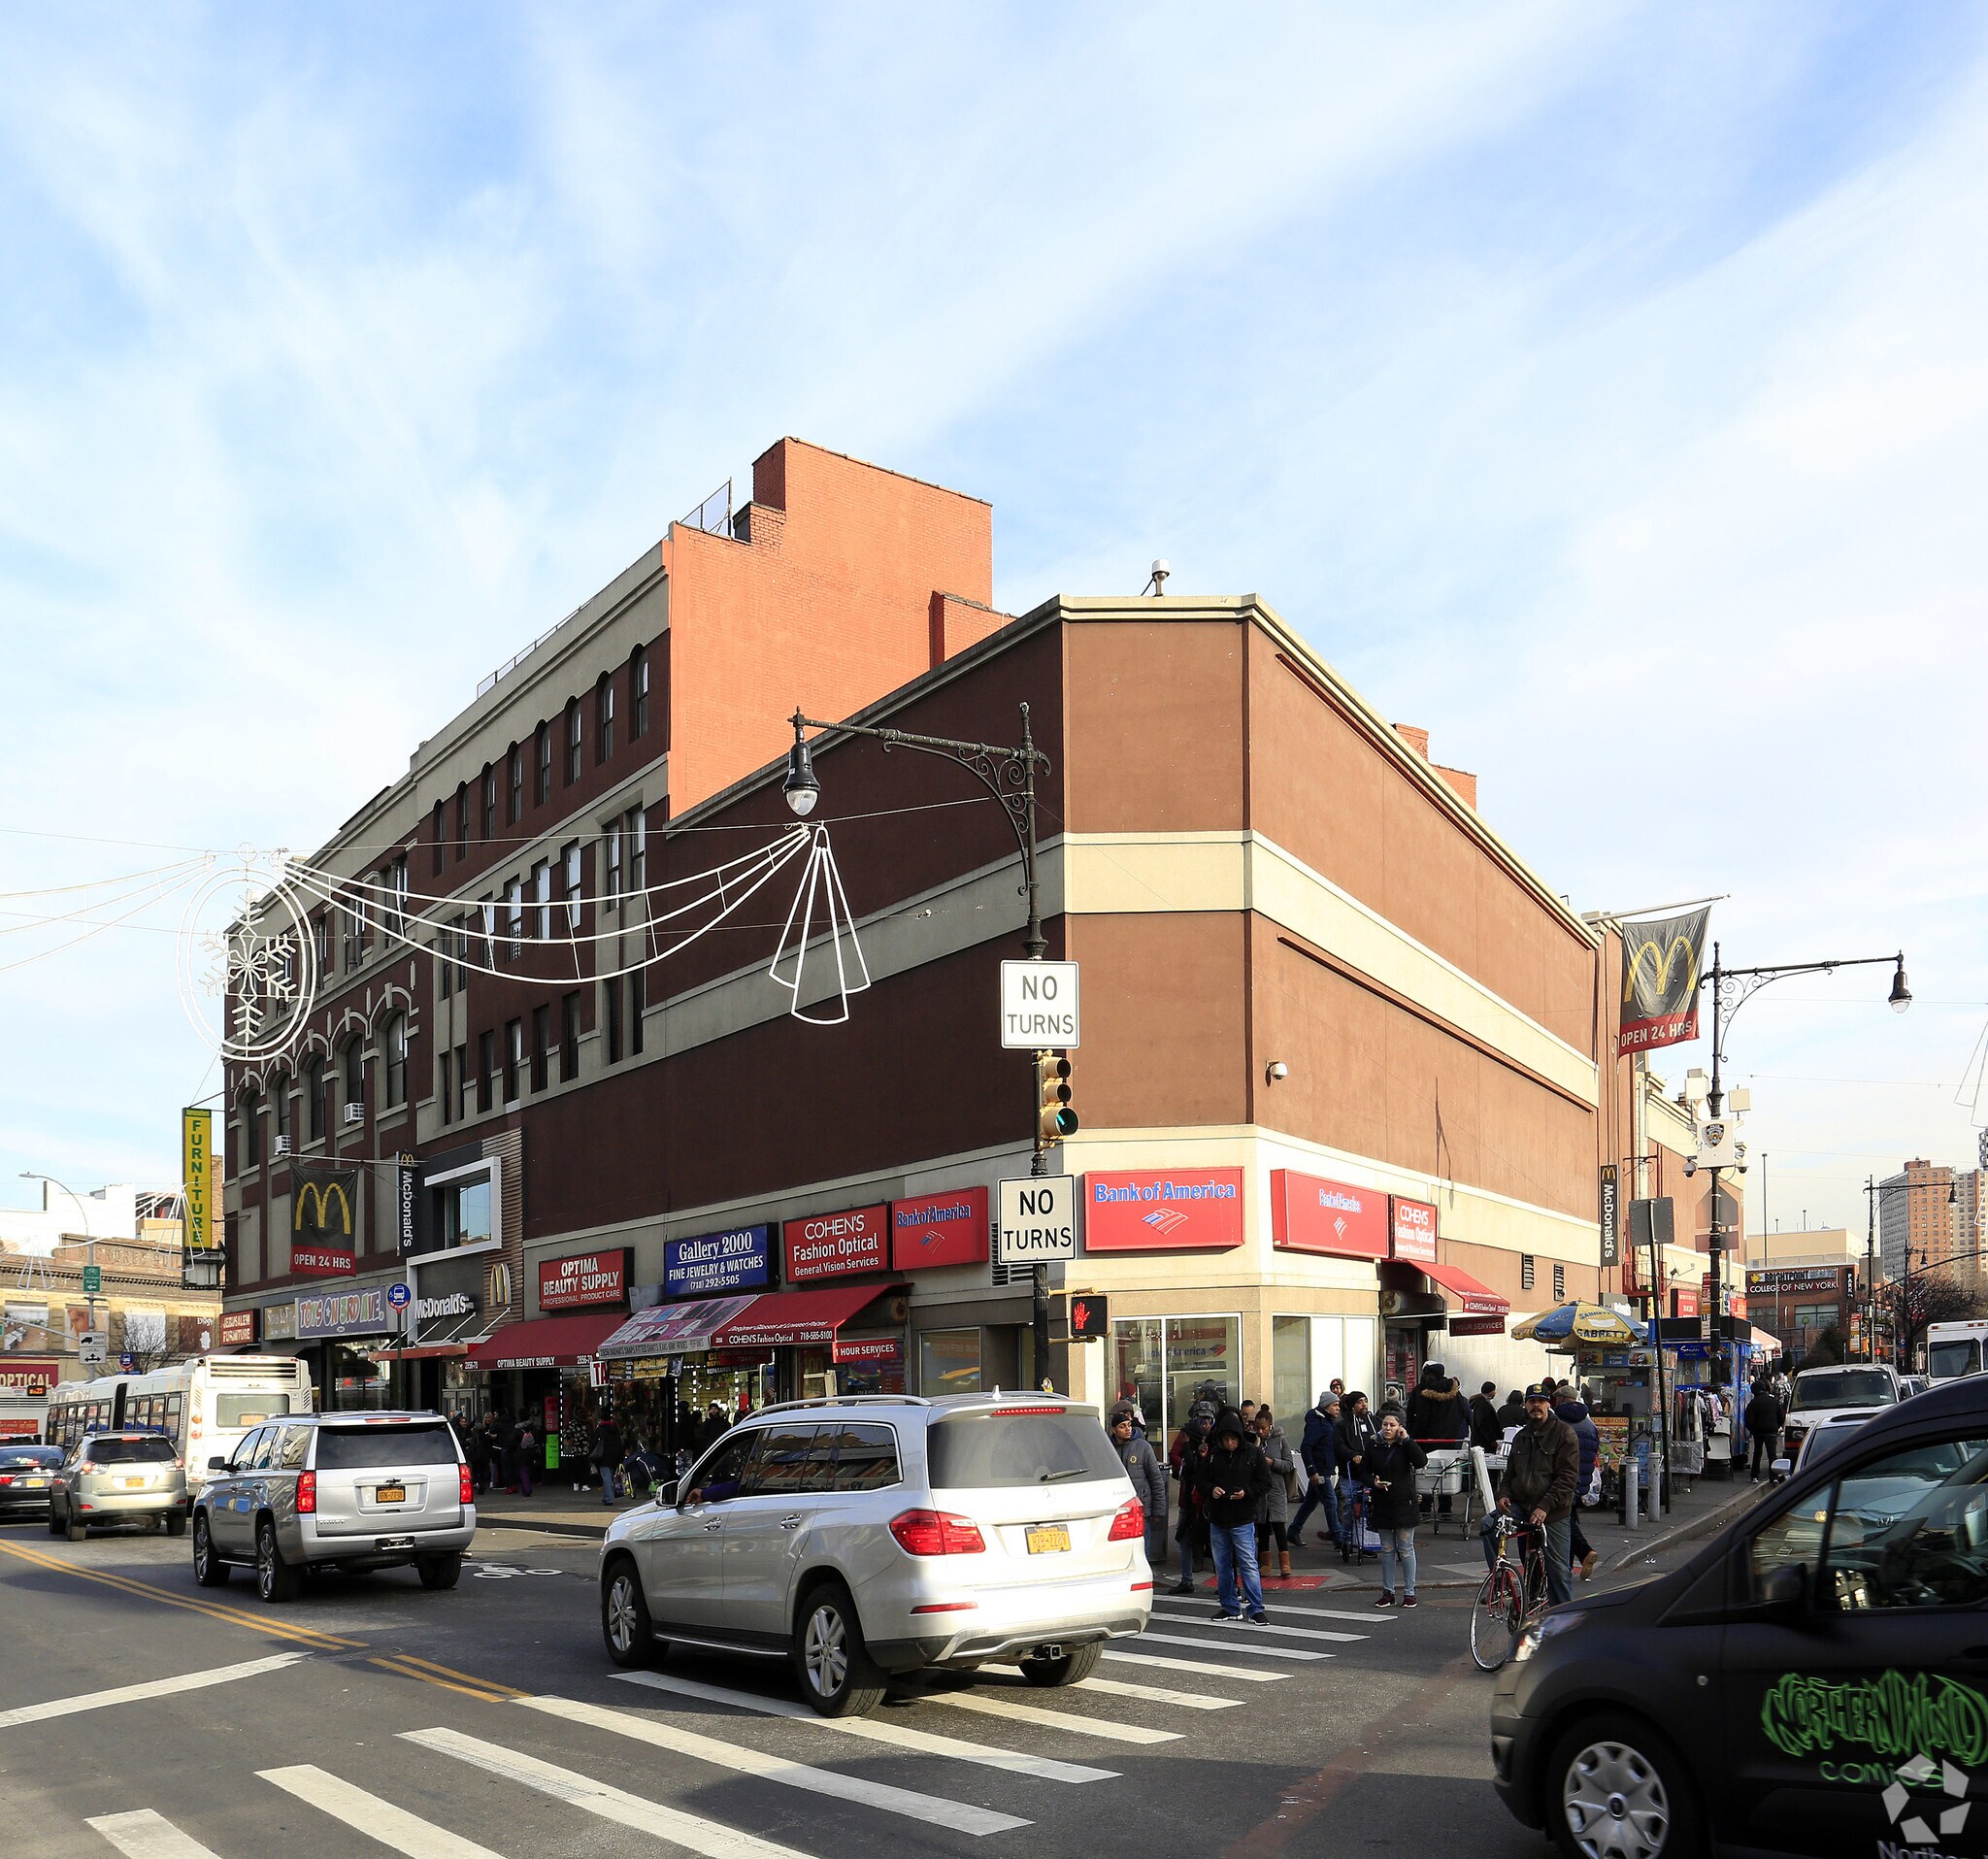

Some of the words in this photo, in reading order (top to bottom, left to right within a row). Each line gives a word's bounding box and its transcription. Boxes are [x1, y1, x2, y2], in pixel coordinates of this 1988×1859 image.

[1022, 975, 1058, 1001] NO
[1007, 1013, 1075, 1035] TURNS
[1621, 1028, 1648, 1047] OPEN
[1651, 1026, 1666, 1041] 24
[1670, 1020, 1693, 1038] HRS
[190, 1119, 203, 1243] FURNITURE
[1094, 1182, 1142, 1203] Bank
[1142, 1180, 1161, 1201] of
[1162, 1179, 1237, 1201] America
[402, 1171, 414, 1247] McDonald's
[1019, 1188, 1054, 1216] NO
[896, 1211, 920, 1228] Bank
[920, 1208, 931, 1224] of
[931, 1202, 972, 1222] America
[1604, 1183, 1614, 1258] McDonald's
[804, 1213, 865, 1241] COHEN'S
[1003, 1226, 1072, 1251] TURNS
[679, 1241, 720, 1261] Gallery
[721, 1231, 752, 1254] 2000
[793, 1242, 836, 1262] Fashion
[838, 1232, 878, 1257] Optical
[294, 1253, 316, 1267] OPEN
[318, 1255, 331, 1267] 24
[332, 1256, 351, 1269] HRS
[560, 1257, 599, 1278] OPTIMA
[669, 1267, 685, 1281] FINE
[685, 1262, 719, 1278] JEWELRY
[719, 1261, 726, 1274] &
[726, 1254, 764, 1273] WATCHES
[794, 1262, 823, 1278] General
[823, 1259, 845, 1274] Vision
[845, 1255, 879, 1270] Services
[543, 1277, 579, 1296] BEAUTY
[581, 1271, 619, 1291] SUPPLY
[690, 1279, 705, 1291] (718)
[705, 1274, 740, 1289] 292-5505
[1749, 1284, 1780, 1293] COLLEGE
[1794, 1282, 1814, 1291] NEW
[300, 1298, 323, 1328] TOYS
[323, 1297, 340, 1327] ON
[340, 1295, 361, 1324] 3RD
[360, 1290, 385, 1323] AVE.
[414, 1292, 468, 1320] McDonald's
[543, 1295, 579, 1306] PROFESSIONAL
[580, 1291, 606, 1301] PRODUCT
[222, 1312, 250, 1328] JERUSALEM
[1474, 1321, 1504, 1330] SERVICES
[1578, 1311, 1612, 1320] SABRETT
[222, 1327, 250, 1343] FURNITURE
[728, 1334, 757, 1344] COHEN'S
[757, 1333, 774, 1344] Fashion
[775, 1332, 794, 1344] Optical
[1576, 1328, 1627, 1339] SABRETT
[841, 1346, 861, 1356] HOUR
[861, 1344, 895, 1355] SERVICES
[497, 1358, 515, 1369] OPTIMA
[515, 1357, 535, 1368] BEAUTY
[536, 1356, 555, 1367] SUPPLY
[0, 1373, 53, 1387] OPTICAL
